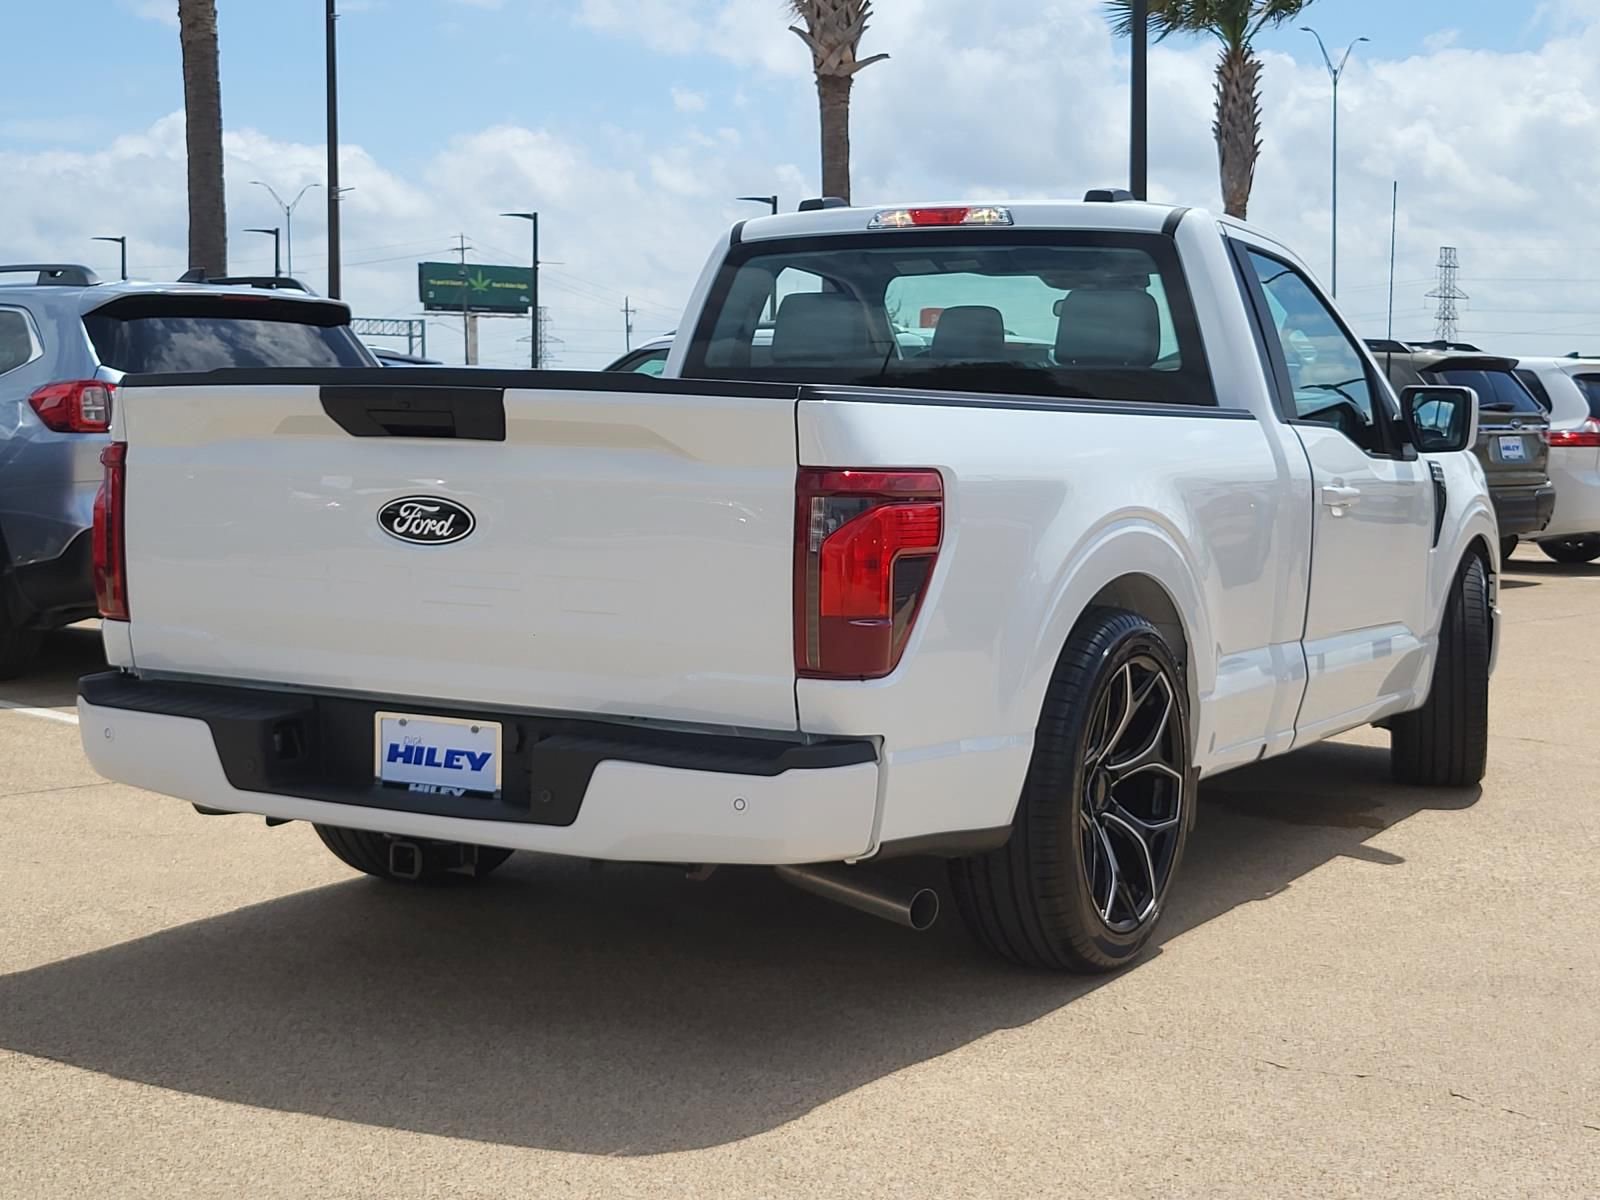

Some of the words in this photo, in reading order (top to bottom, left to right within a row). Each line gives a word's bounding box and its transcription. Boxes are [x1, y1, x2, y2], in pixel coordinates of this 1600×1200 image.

[393, 503, 455, 536] Ford
[387, 743, 492, 772] HILEY
[408, 783, 466, 797] HILEY
